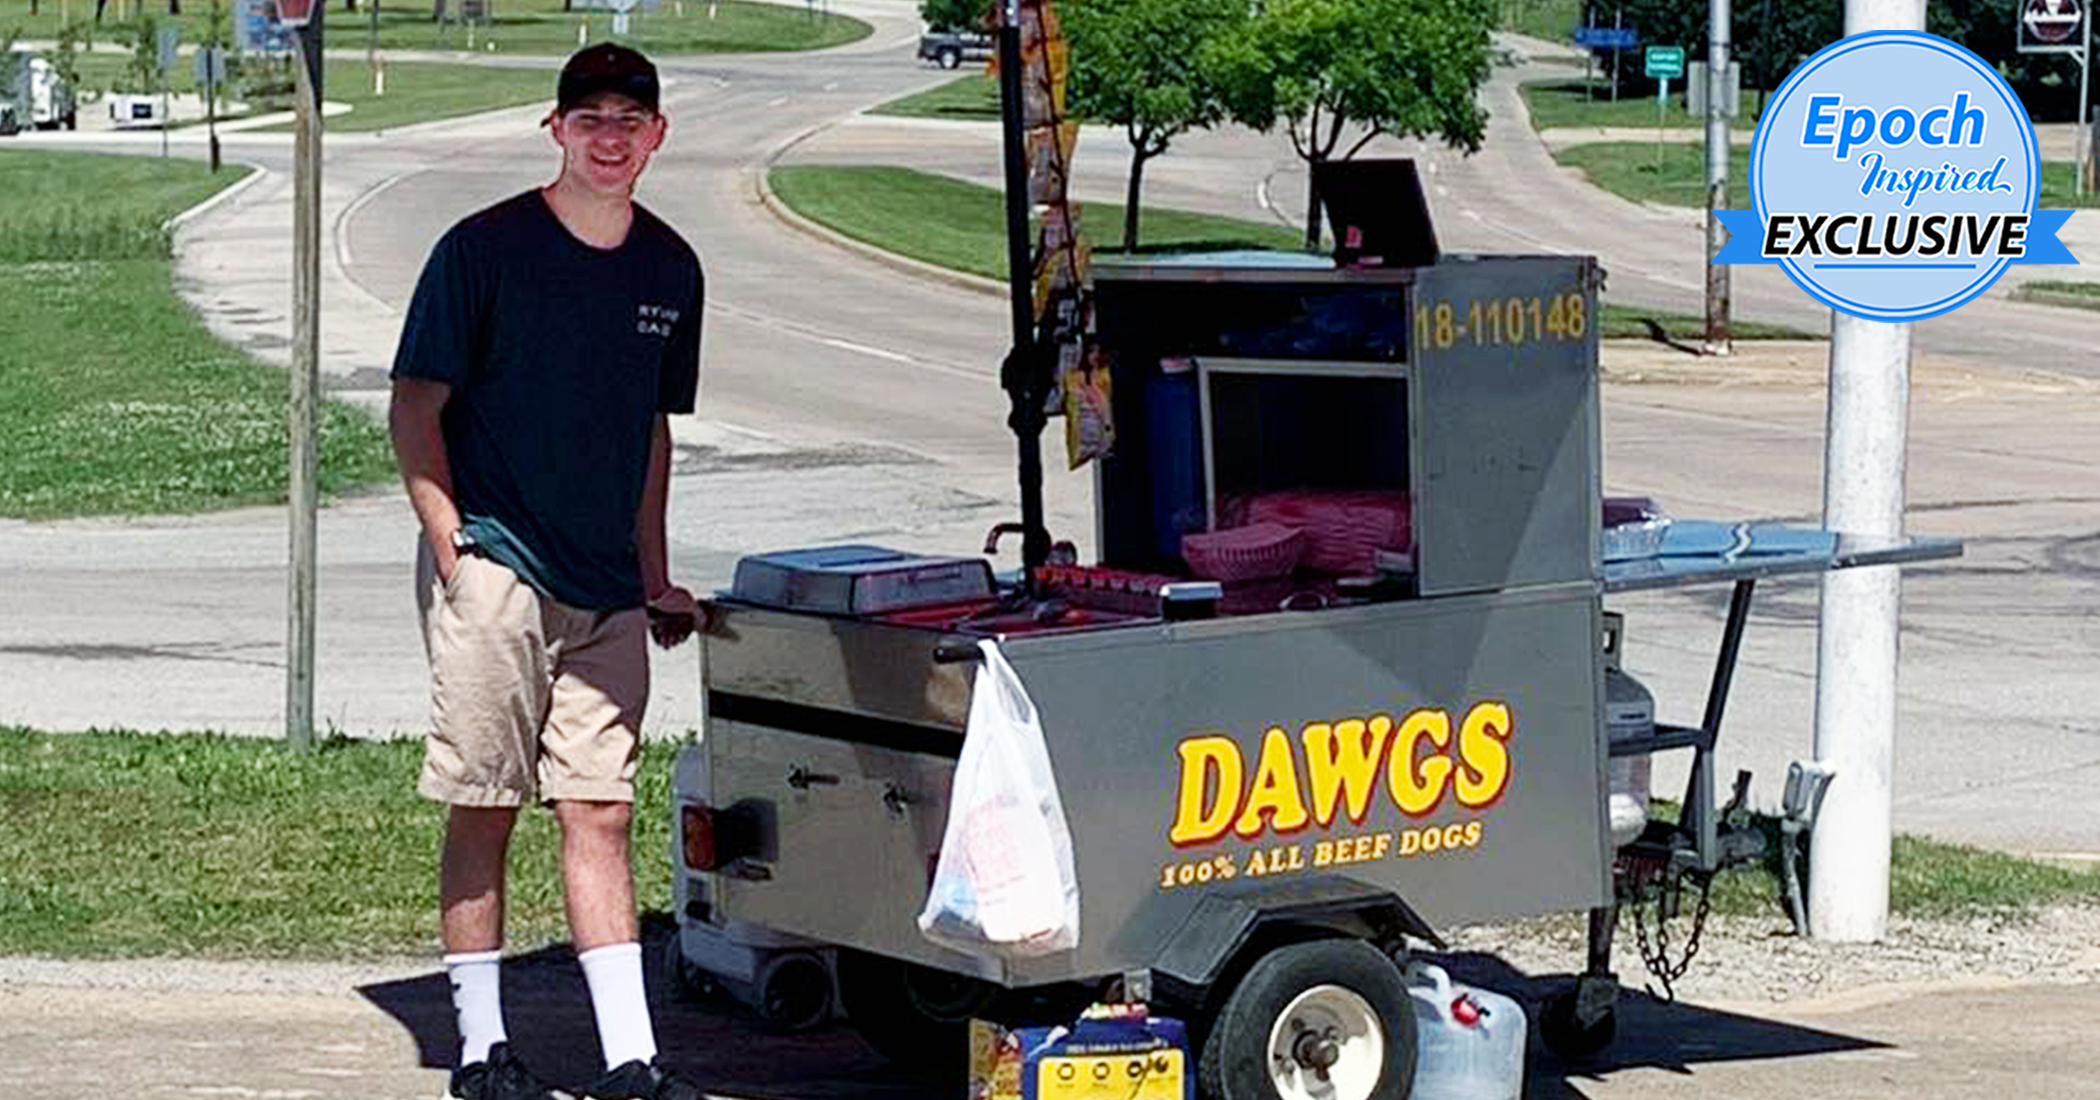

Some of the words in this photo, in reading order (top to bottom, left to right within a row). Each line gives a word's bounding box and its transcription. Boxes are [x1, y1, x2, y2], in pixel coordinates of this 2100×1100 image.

[1416, 294, 1585, 349] 18-110148
[1170, 702, 1512, 845] DAWGS
[1160, 855, 1237, 888] 100%
[1245, 847, 1305, 876] ALL
[1314, 833, 1391, 867] BEEF
[1399, 820, 1482, 856] DOGS
